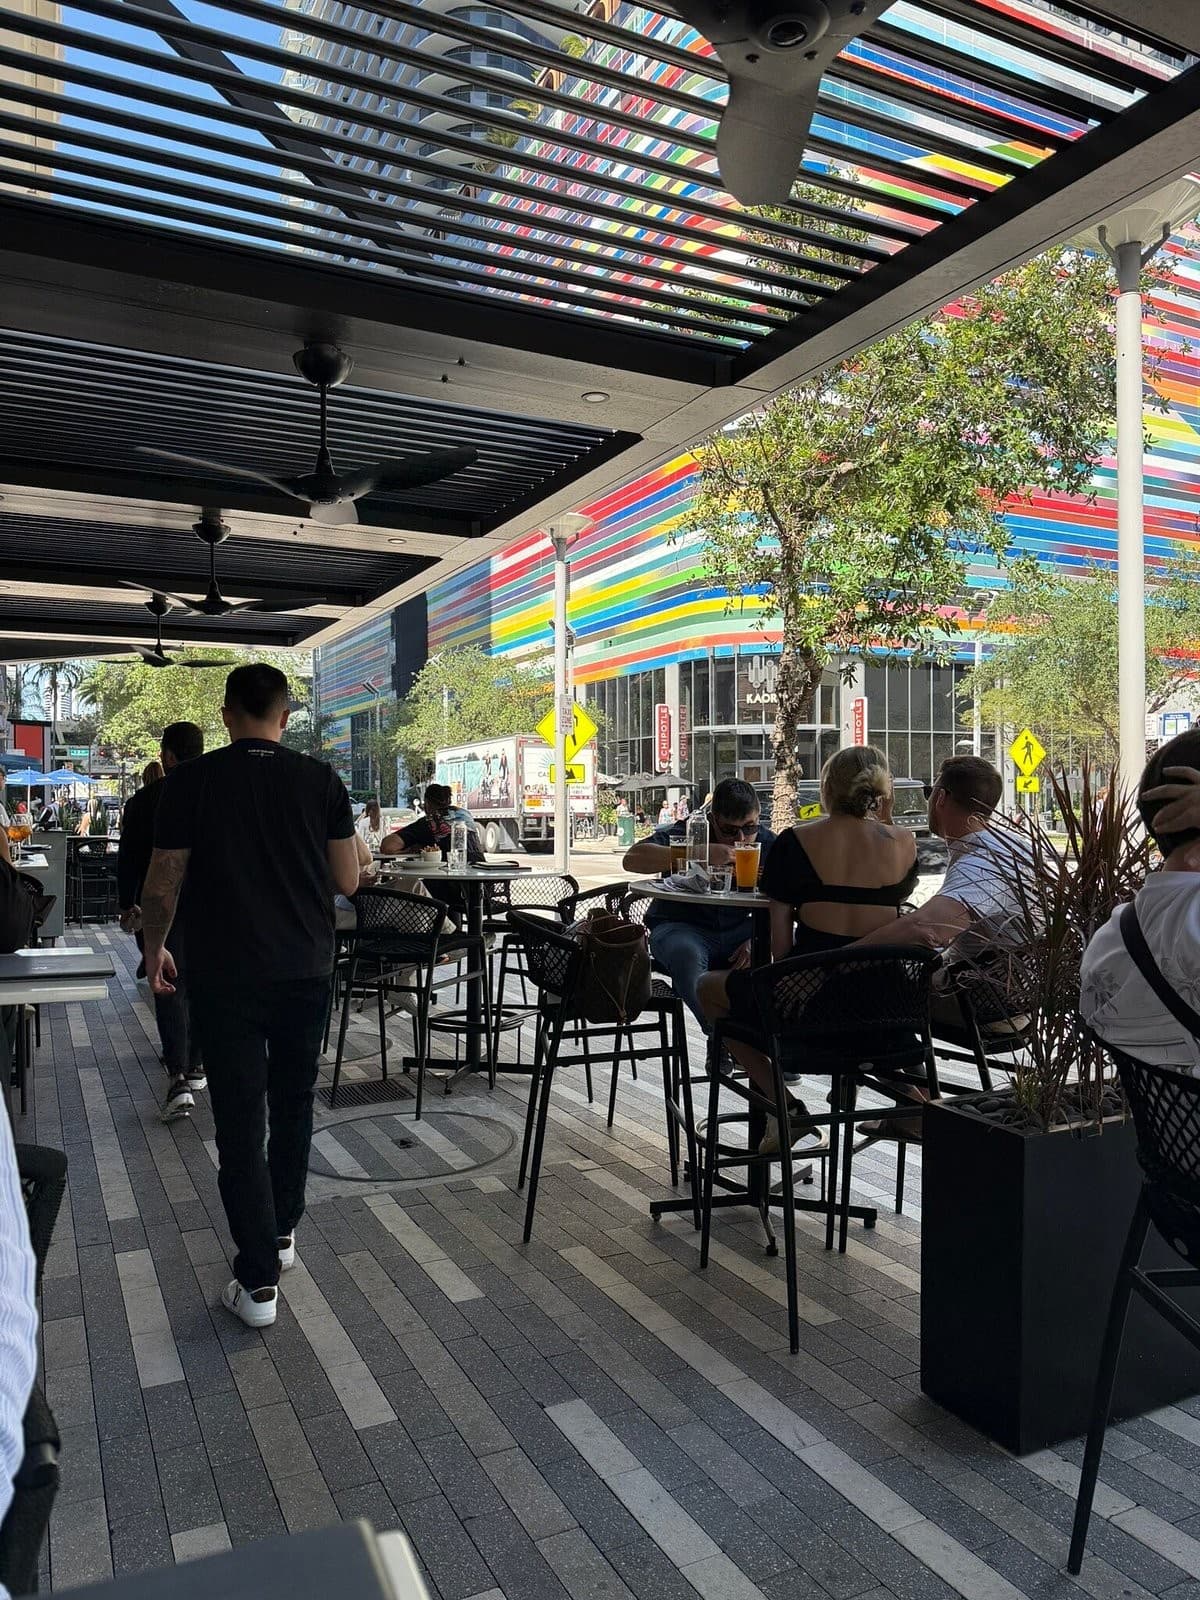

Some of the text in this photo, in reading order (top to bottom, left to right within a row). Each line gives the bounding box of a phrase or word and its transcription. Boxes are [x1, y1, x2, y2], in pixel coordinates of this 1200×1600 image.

[746, 693, 778, 704] KAOR
[660, 706, 668, 757] CHIPOTLE
[855, 700, 863, 746] HIPOTLE
